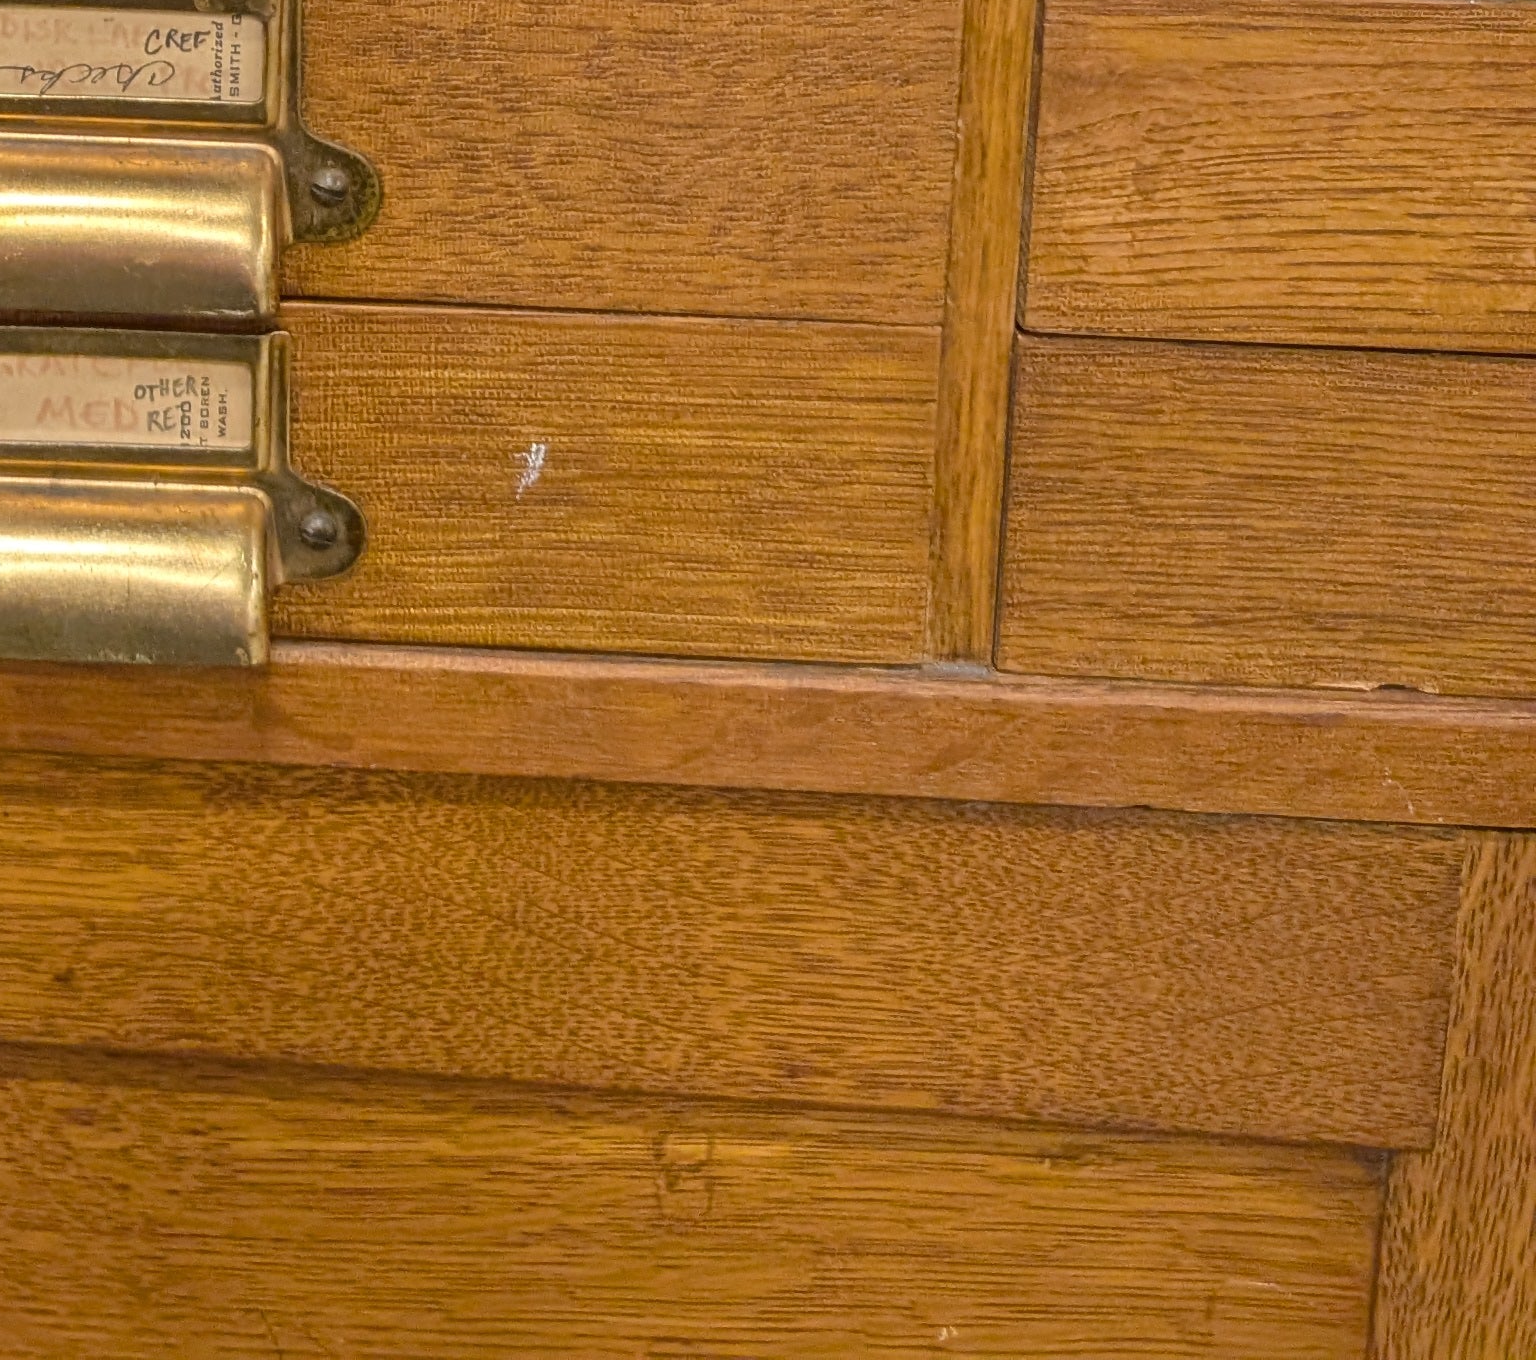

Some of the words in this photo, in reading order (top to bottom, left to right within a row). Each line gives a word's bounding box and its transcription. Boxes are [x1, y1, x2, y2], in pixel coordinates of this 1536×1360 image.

[144, 28, 211, 55] CREF
[229, 44, 241, 97] SMITH
[133, 374, 200, 402] OTHER
[200, 376, 210, 429] BOREN
[218, 388, 229, 437] WASH.
